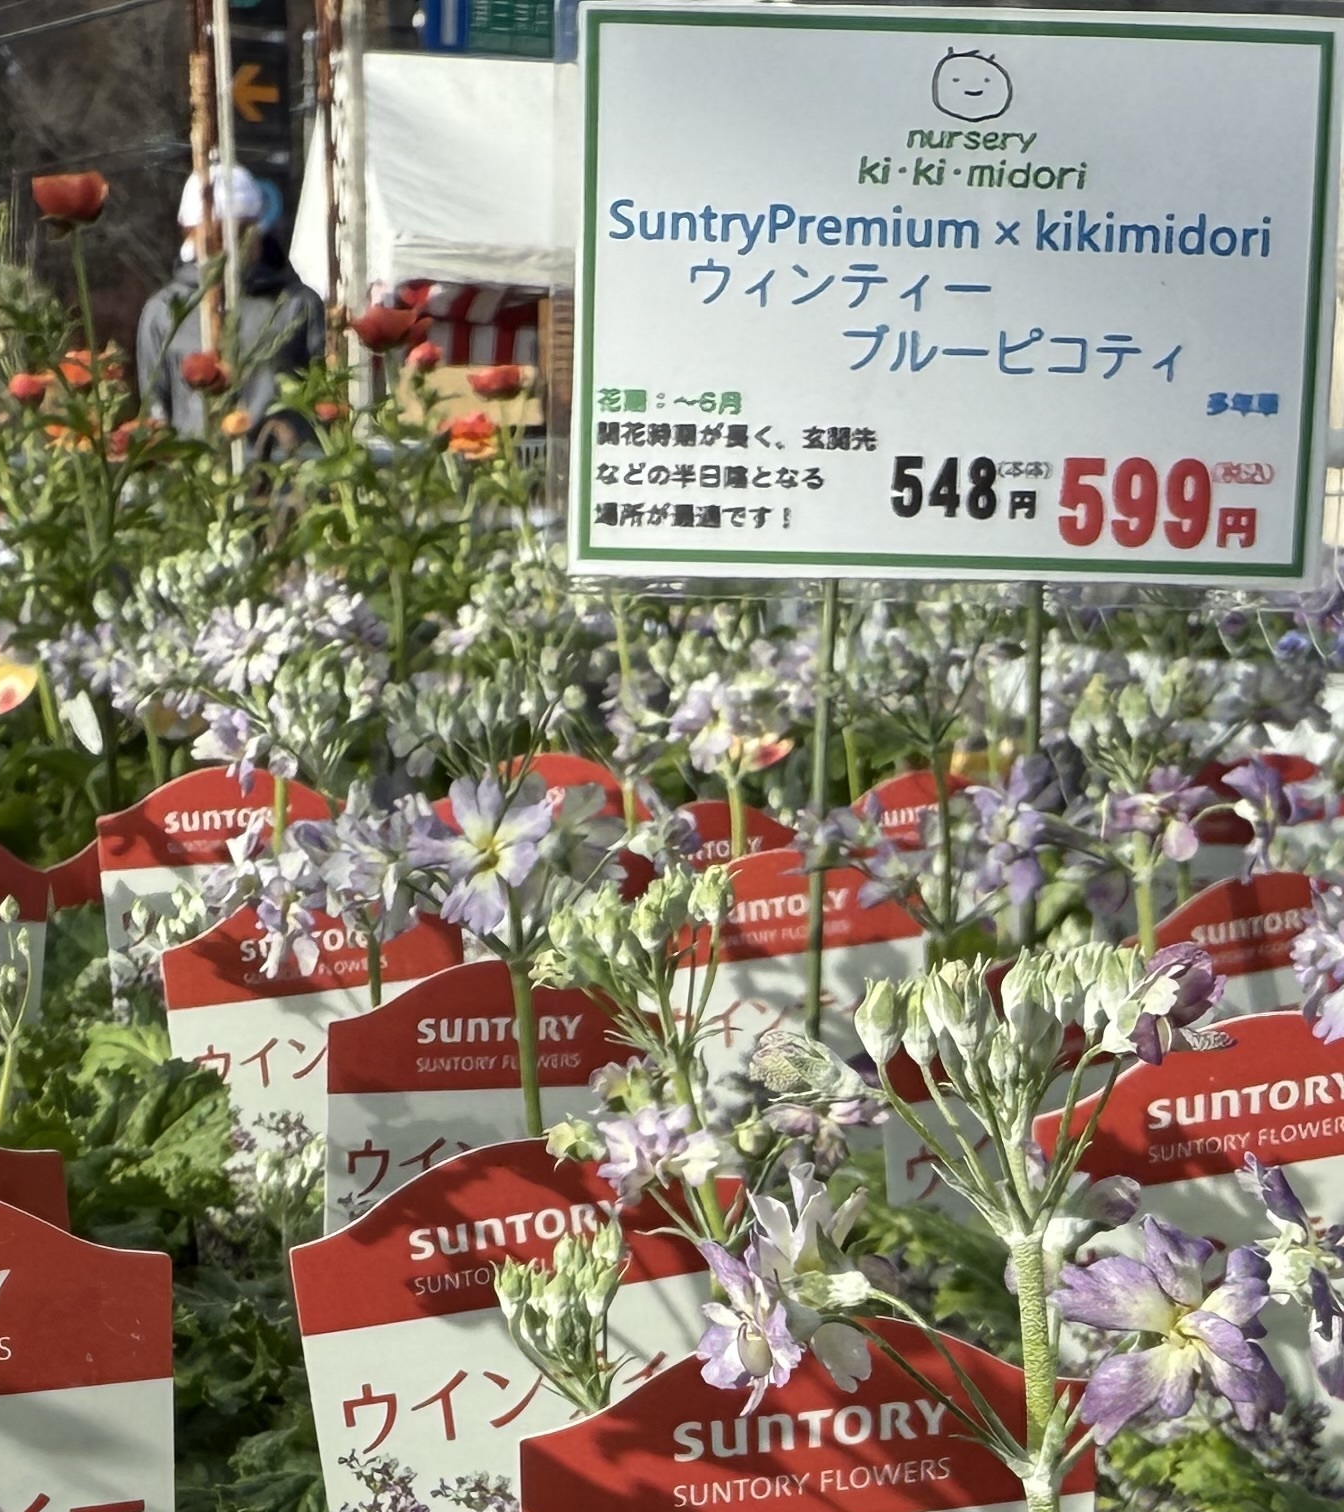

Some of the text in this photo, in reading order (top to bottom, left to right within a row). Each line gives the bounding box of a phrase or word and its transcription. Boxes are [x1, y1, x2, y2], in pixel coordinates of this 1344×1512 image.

[907, 127, 1037, 154] nursery
[608, 199, 980, 256] SuntryPremium
[1037, 210, 1272, 258] kikimidori
[689, 260, 992, 312] ウィンティー
[843, 324, 1185, 382] ブルーピコティ
[1148, 1132, 1251, 1165] SUNTORY
[673, 1398, 953, 1463] SUNTORY
[673, 1456, 952, 1508] SUNTORY FLOWERS
